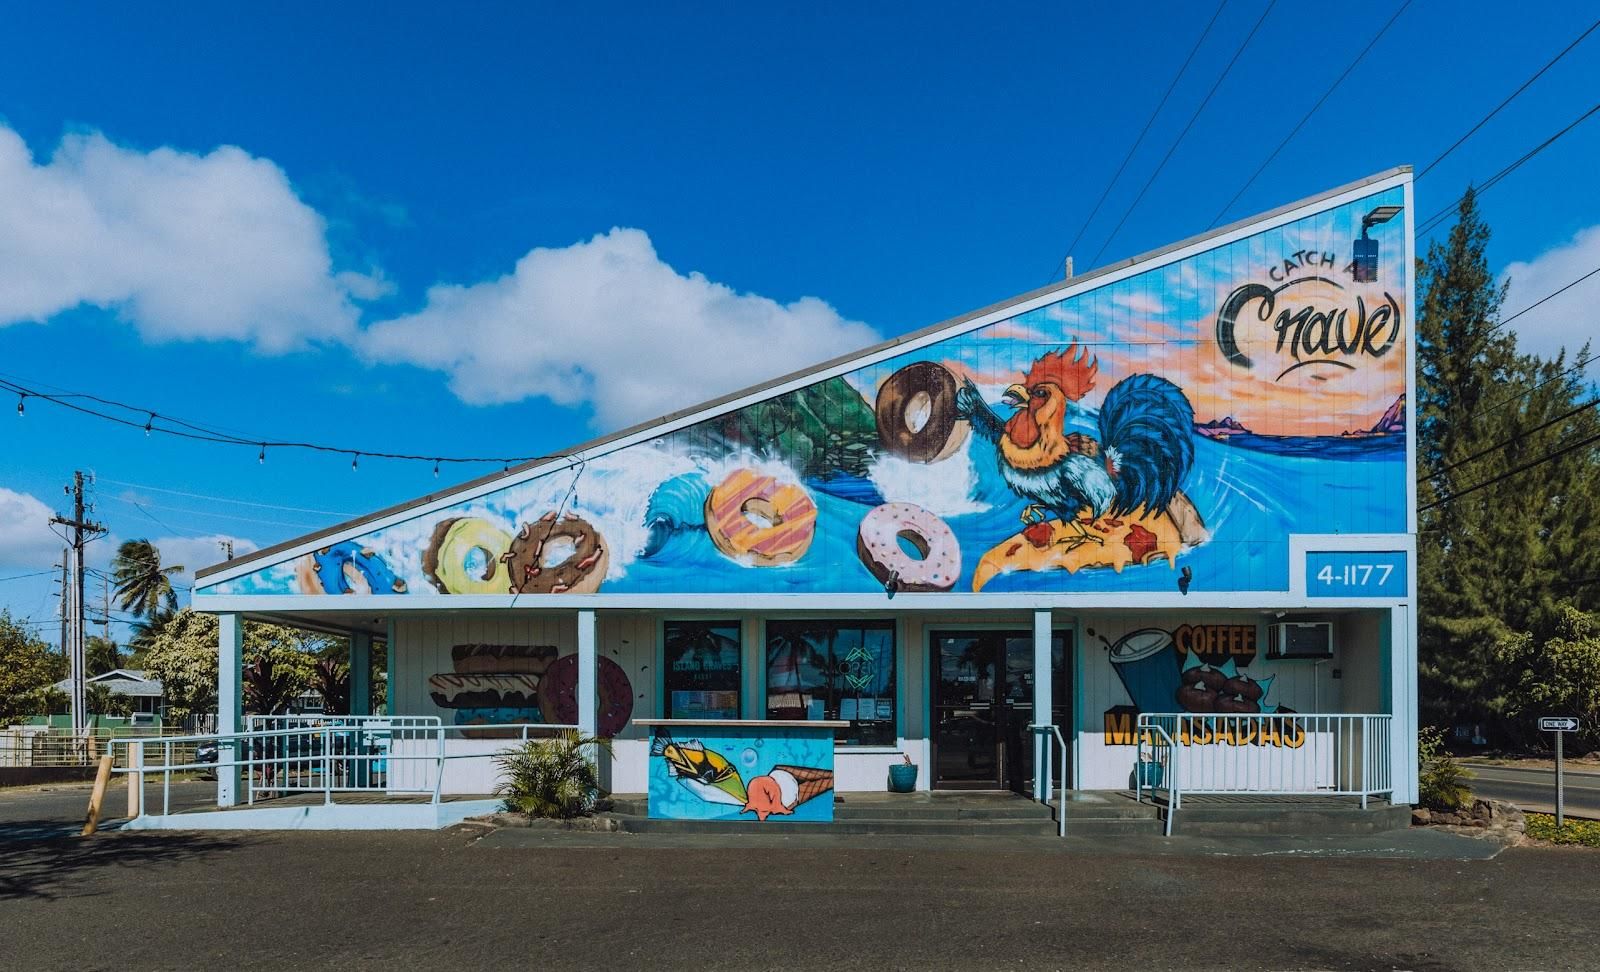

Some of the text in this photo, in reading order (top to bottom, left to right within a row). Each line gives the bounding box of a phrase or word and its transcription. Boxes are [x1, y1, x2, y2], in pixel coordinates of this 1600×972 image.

[1269, 250, 1335, 282] CATCH
[1216, 283, 1400, 369] Crave
[1317, 564, 1394, 585] 4-1177
[1175, 624, 1256, 655] COFFEE
[838, 661, 878, 674] OPEN
